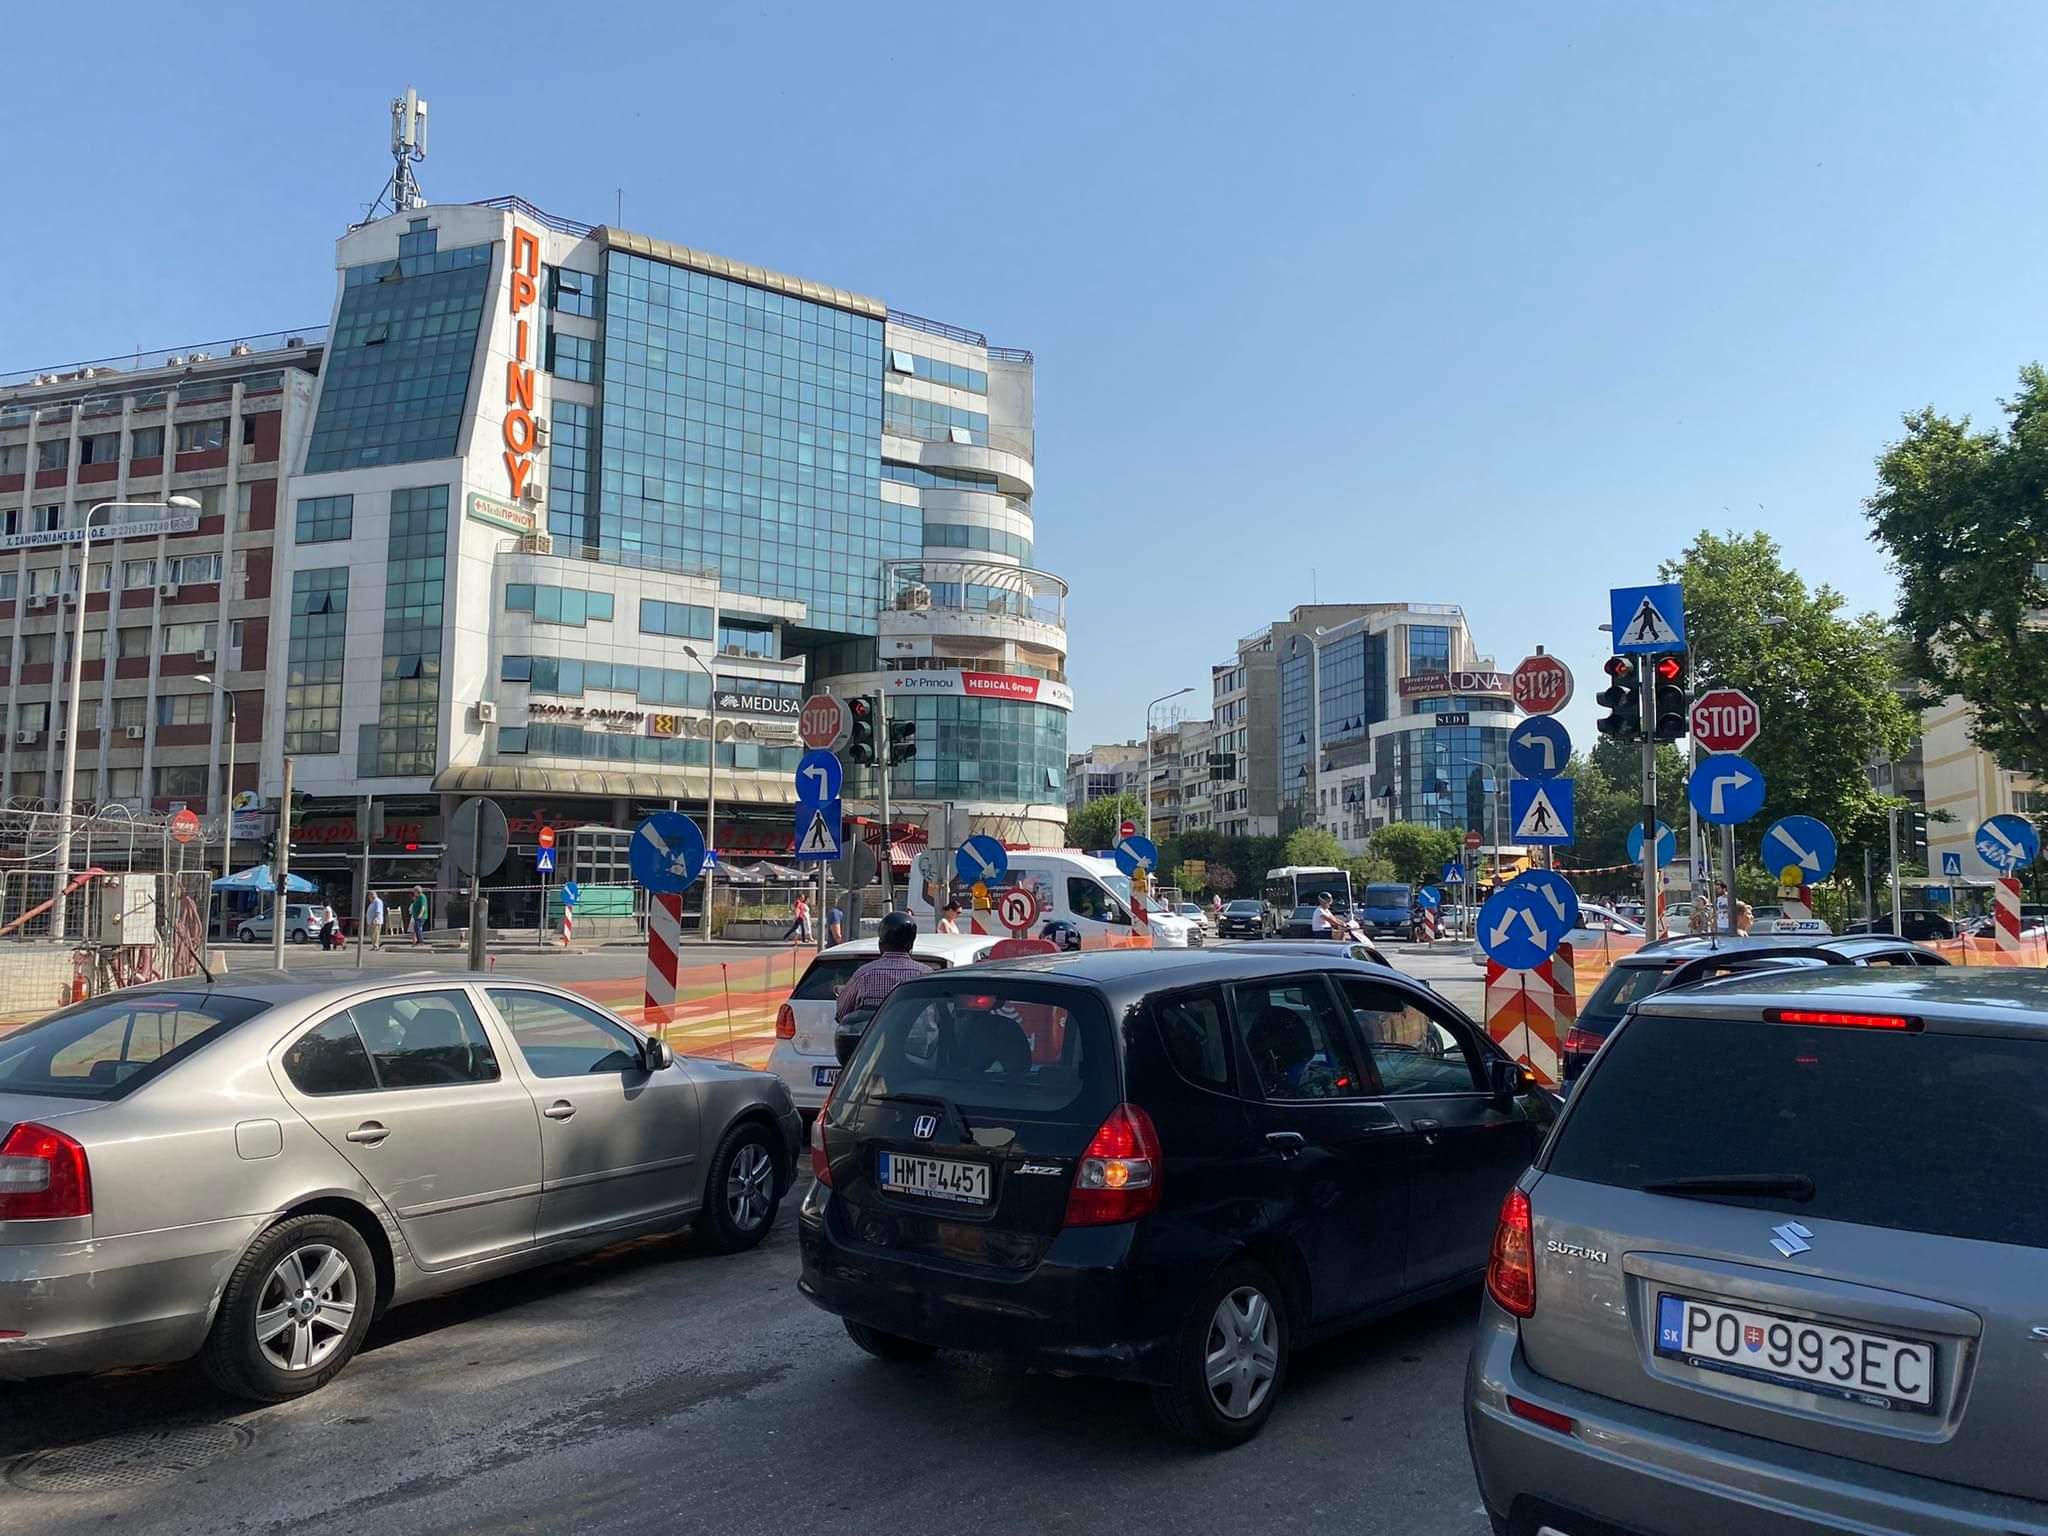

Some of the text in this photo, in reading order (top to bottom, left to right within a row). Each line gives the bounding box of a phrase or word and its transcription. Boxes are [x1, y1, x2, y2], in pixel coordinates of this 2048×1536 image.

[504, 226, 540, 499] ΠΡΙΝΟΥ
[905, 677, 918, 688] Dr
[969, 678, 1034, 695] MEDICAL Group
[1460, 672, 1502, 690] DNA
[1515, 669, 1563, 701] STOP
[528, 703, 585, 718] ΣΧΟΛΣ
[741, 695, 801, 713] MEDUSA
[802, 707, 838, 737] STOP
[1695, 705, 1753, 738] STOP
[1546, 1240, 1608, 1264] SUZUKI
[1663, 1328, 1679, 1343] SK
